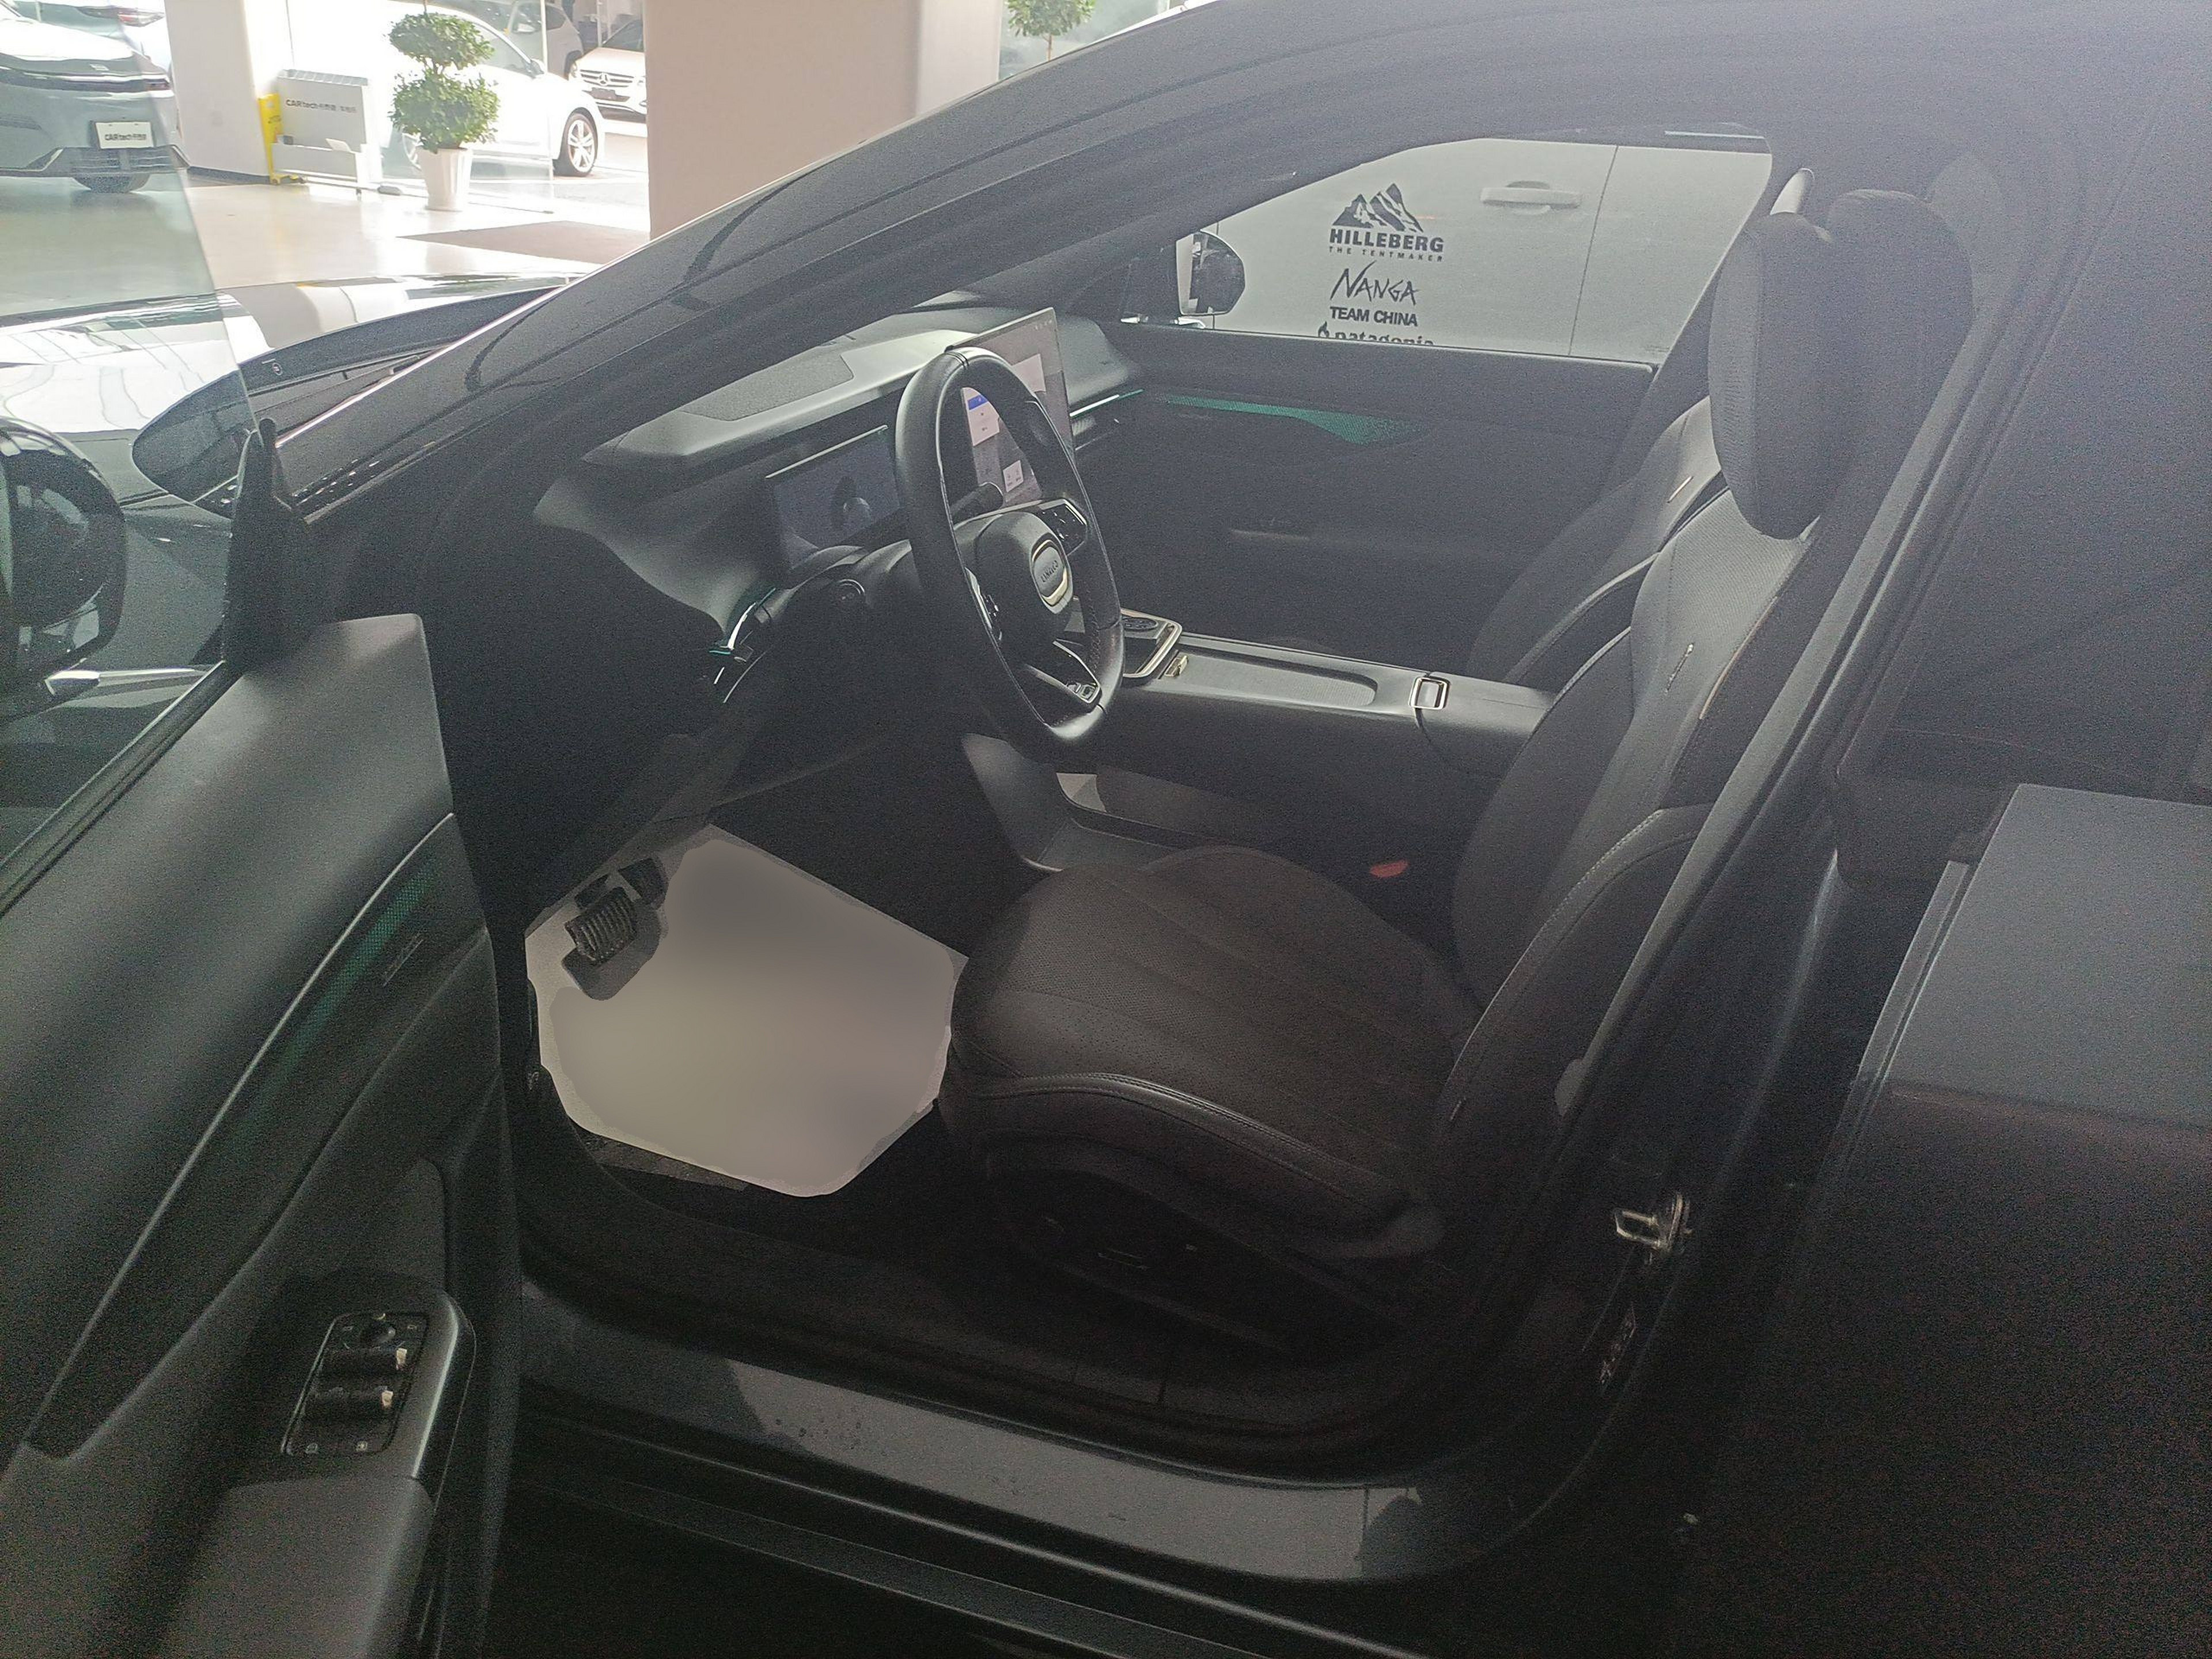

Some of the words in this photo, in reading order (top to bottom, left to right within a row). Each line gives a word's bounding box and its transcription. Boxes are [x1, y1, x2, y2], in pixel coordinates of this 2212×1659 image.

[1330, 228, 1445, 252] HILLEBERG
[1329, 246, 1352, 255] THE
[1362, 249, 1442, 262] TENTMAKER
[1330, 260, 1418, 306] NANGA
[1330, 306, 1370, 323] TEAM
[1373, 310, 1418, 327] CHINA
